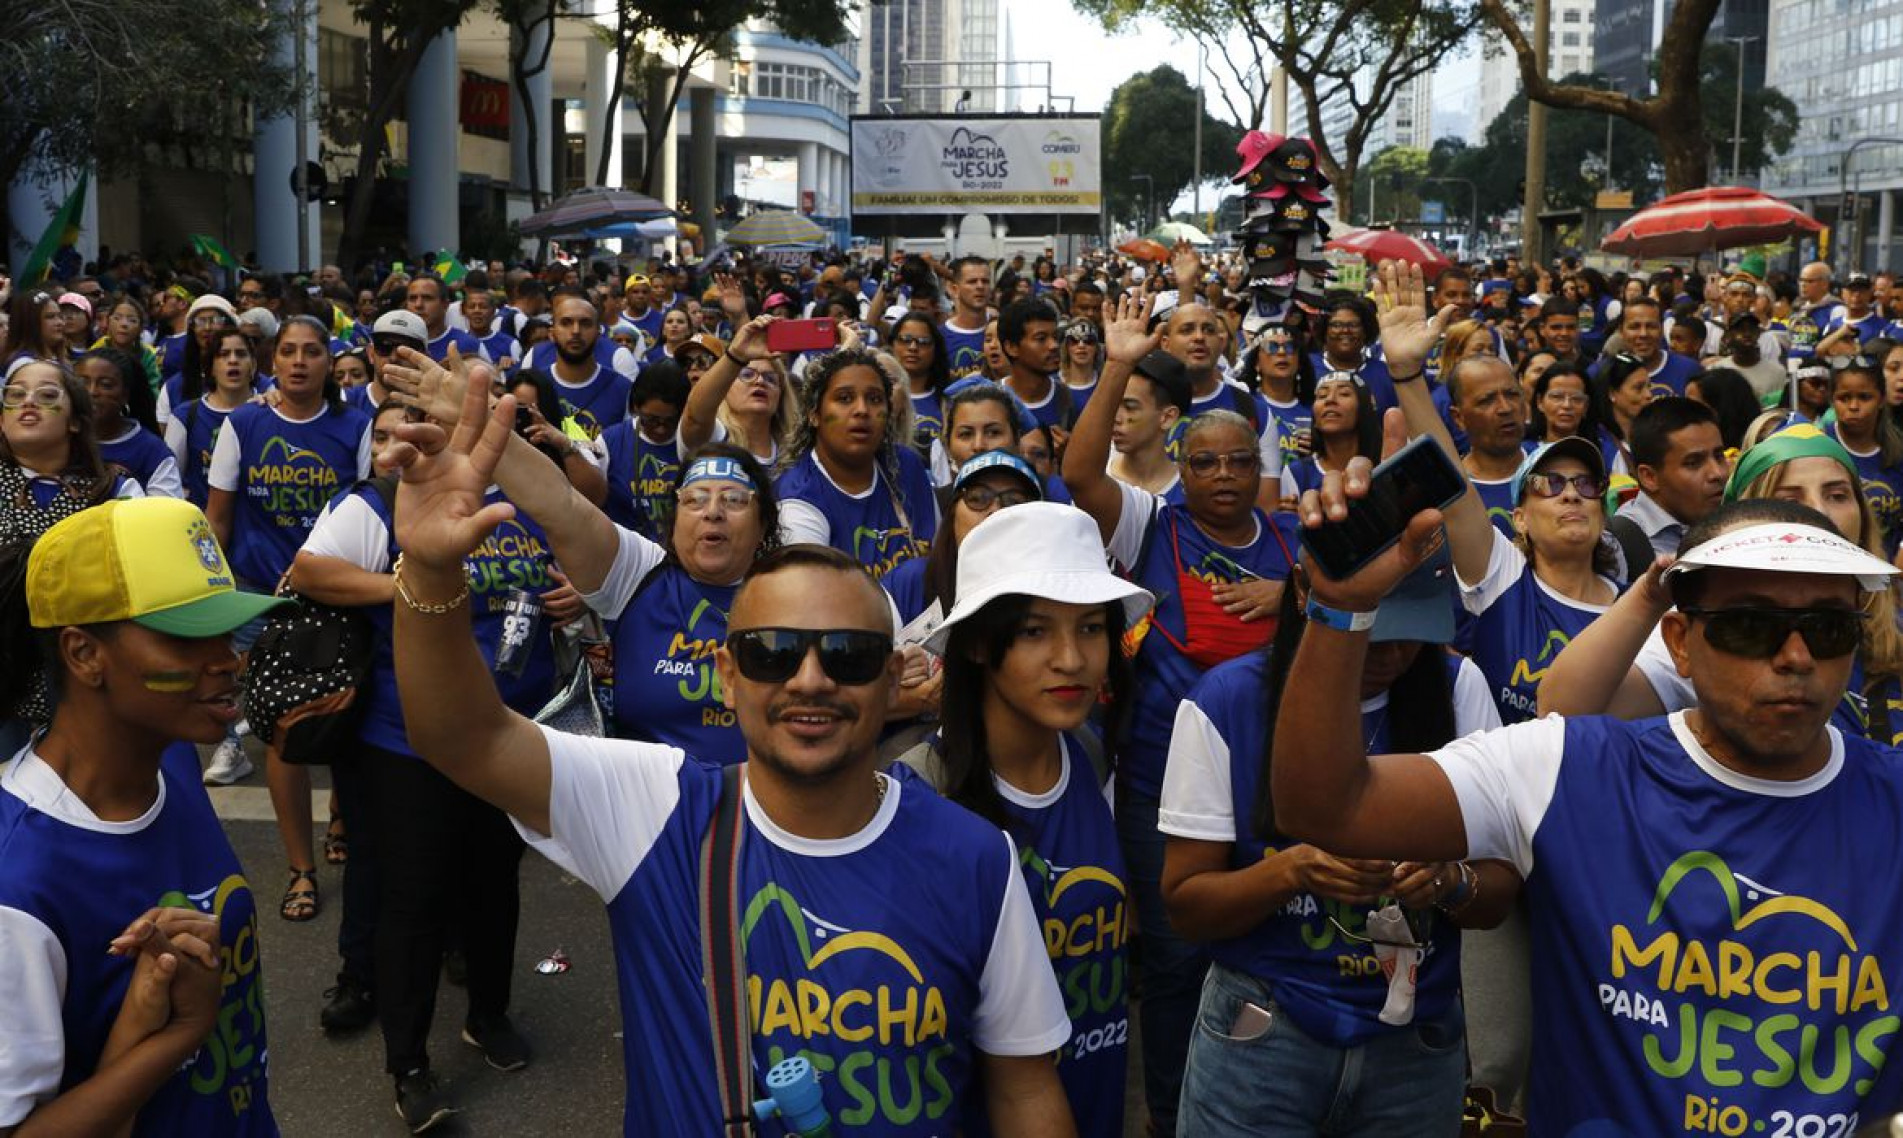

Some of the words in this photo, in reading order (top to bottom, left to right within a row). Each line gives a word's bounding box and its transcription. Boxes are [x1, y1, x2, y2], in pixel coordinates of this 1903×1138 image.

[943, 146, 1006, 160] MARCHA
[952, 160, 1008, 178] JESUS
[249, 464, 338, 487] MARCHA
[247, 486, 269, 497] PARA
[468, 534, 548, 558] ARCHA
[504, 615, 531, 639] 93
[654, 659, 695, 676] PARA
[1502, 687, 1537, 714] PARA
[1611, 924, 1889, 1014] MARCHA
[748, 974, 948, 1047] ARCHA
[1074, 1018, 1128, 1060] 2022
[1598, 983, 1669, 1028] PARA
[1642, 1003, 1901, 1096] JESUS
[767, 1043, 955, 1126] SUS
